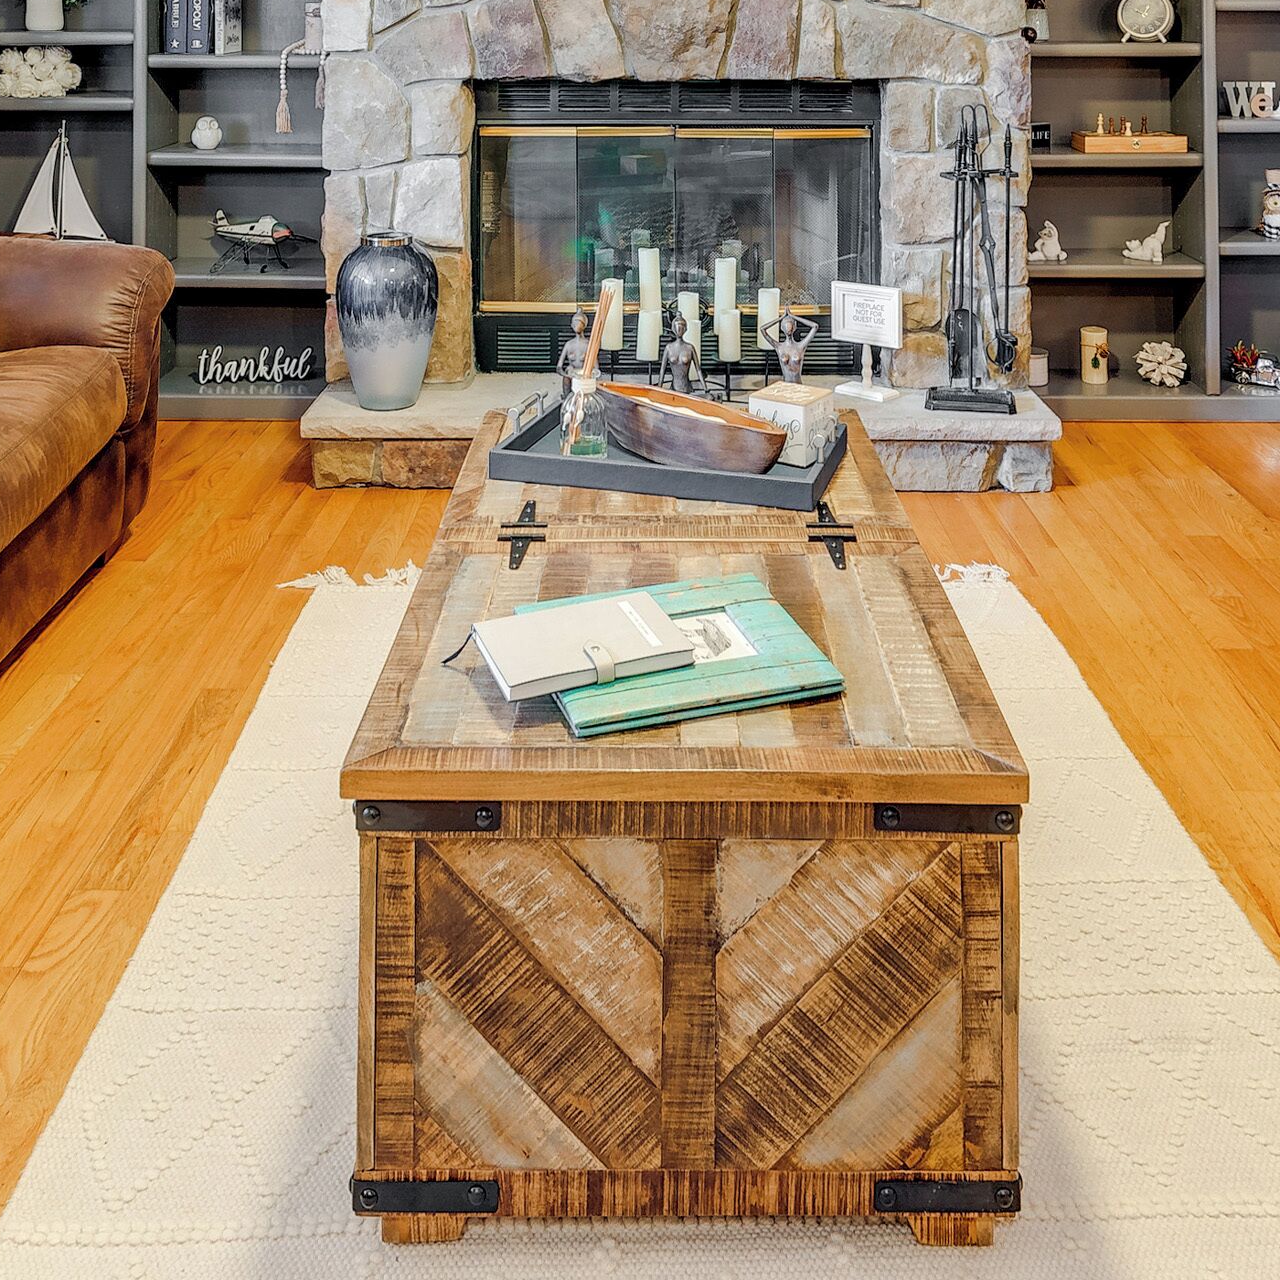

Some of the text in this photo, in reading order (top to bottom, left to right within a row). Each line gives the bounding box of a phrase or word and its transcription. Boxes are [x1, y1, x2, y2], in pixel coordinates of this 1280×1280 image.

[1032, 131, 1050, 140] LIFE
[853, 302, 885, 311] FIREPLACE
[198, 345, 313, 385] thankful
